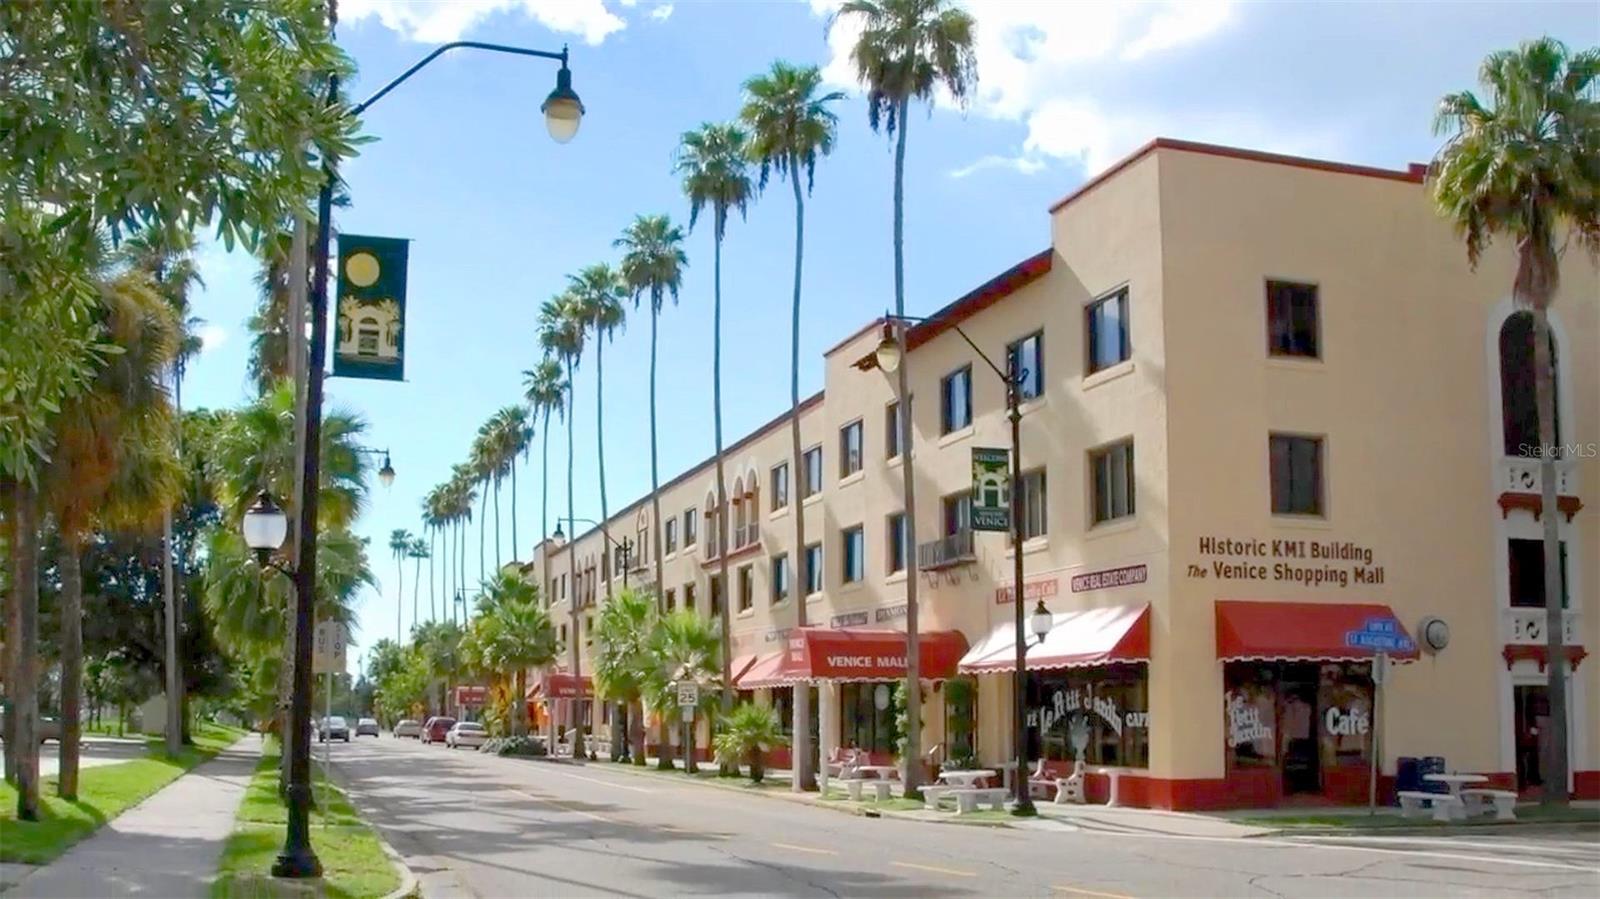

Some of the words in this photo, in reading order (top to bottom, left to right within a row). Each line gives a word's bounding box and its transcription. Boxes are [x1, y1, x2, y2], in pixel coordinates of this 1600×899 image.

[1199, 536, 1267, 557] Historic
[1271, 539, 1306, 558] KMI
[1310, 542, 1373, 565] Building
[1187, 564, 1208, 578] The
[1213, 561, 1267, 580] Venice
[1273, 563, 1348, 587] Shopping
[1354, 566, 1385, 584] Mall
[827, 655, 872, 668] VENICE
[680, 693, 697, 703] 25
[1326, 706, 1370, 736] Café
